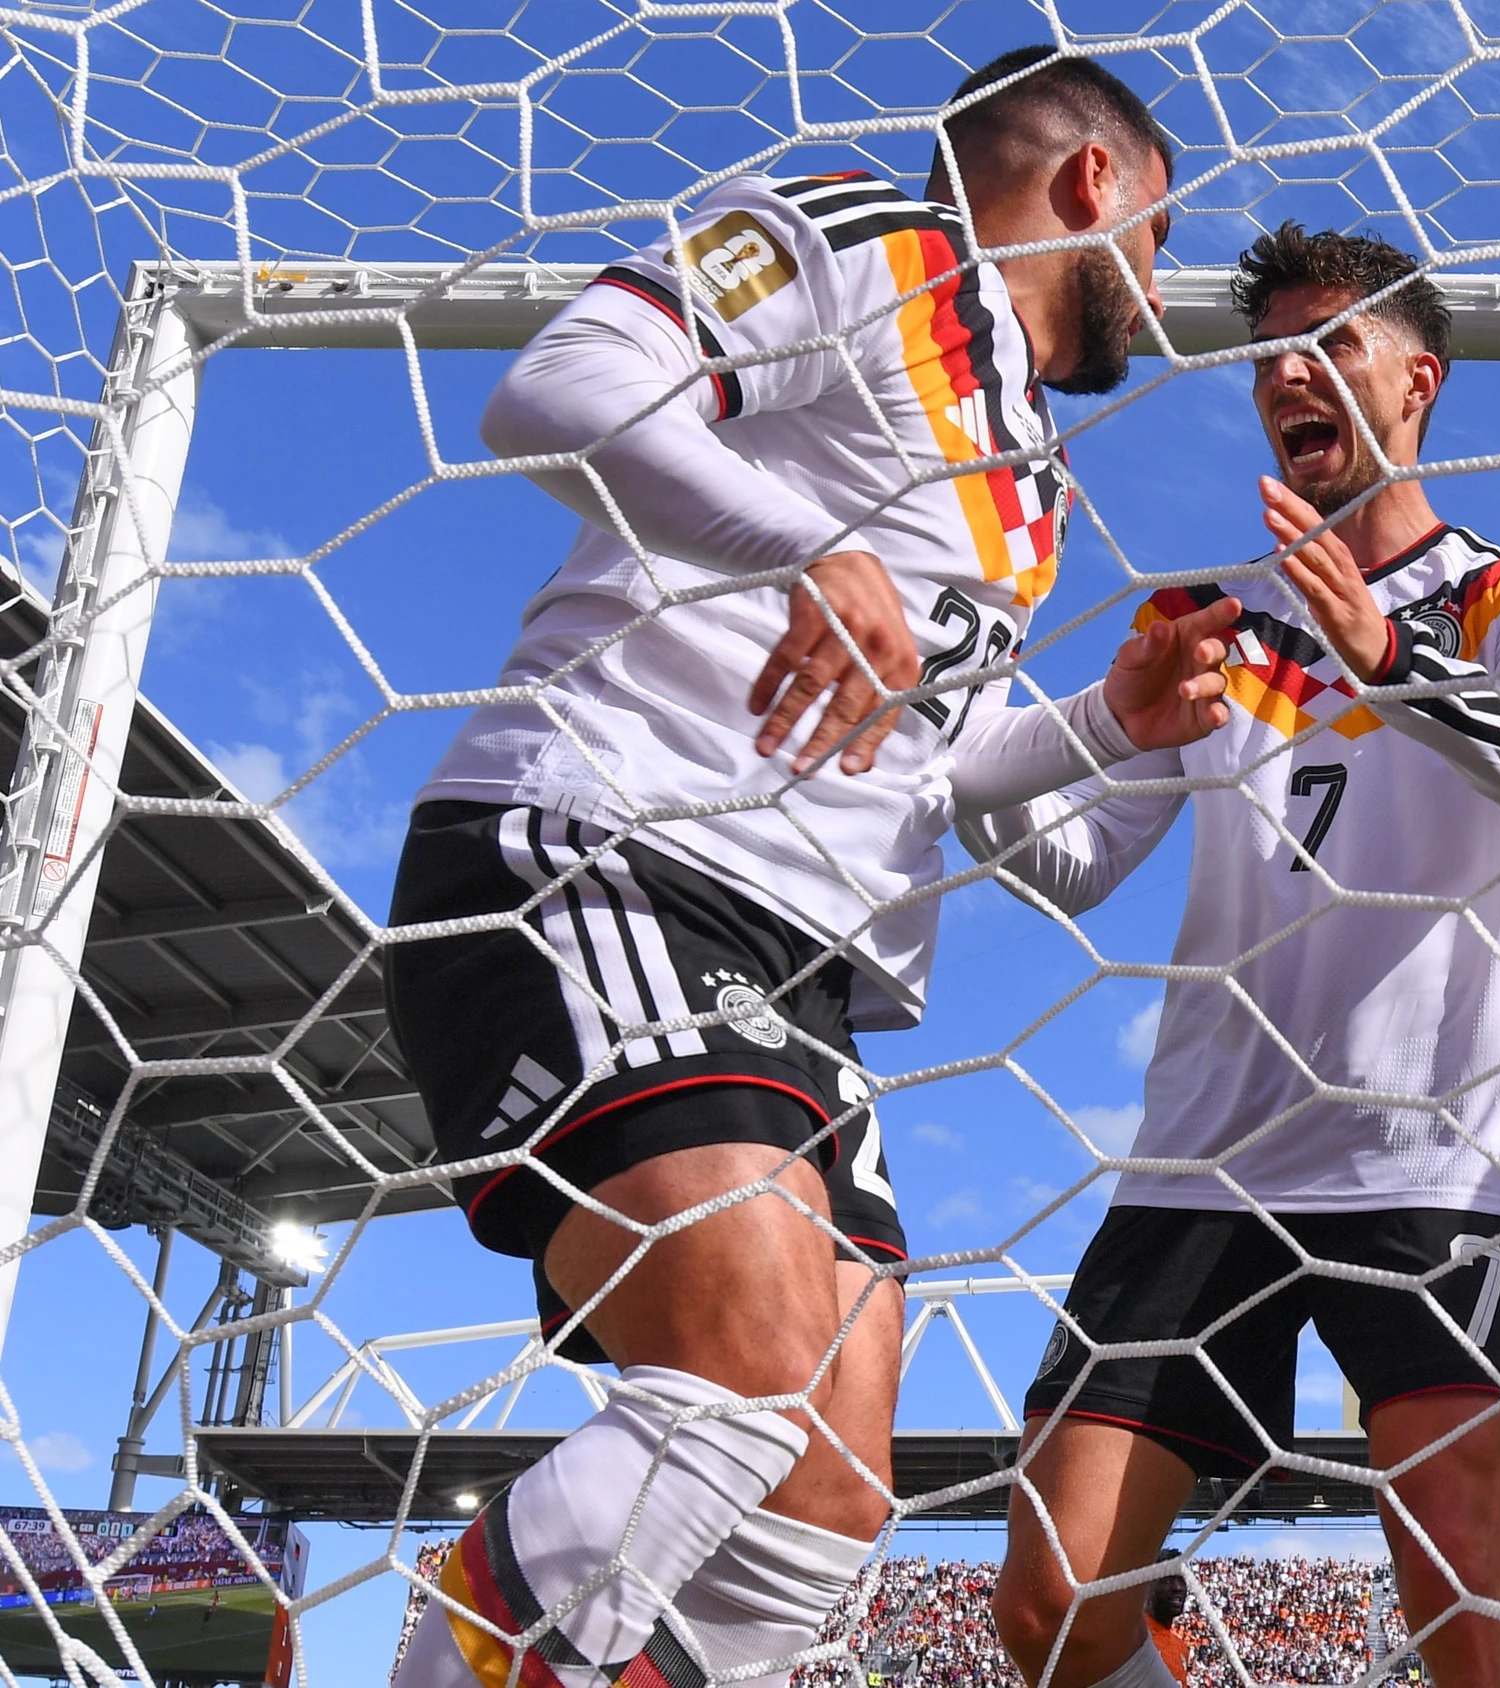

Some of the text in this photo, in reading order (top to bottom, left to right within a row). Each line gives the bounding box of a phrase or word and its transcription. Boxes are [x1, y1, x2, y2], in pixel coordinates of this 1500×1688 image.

[711, 264, 728, 281] FIFA
[1290, 763, 1347, 872] 7
[13, 1520, 46, 1532] 67:39
[211, 1575, 258, 1587] QATAR AIRWAYS
